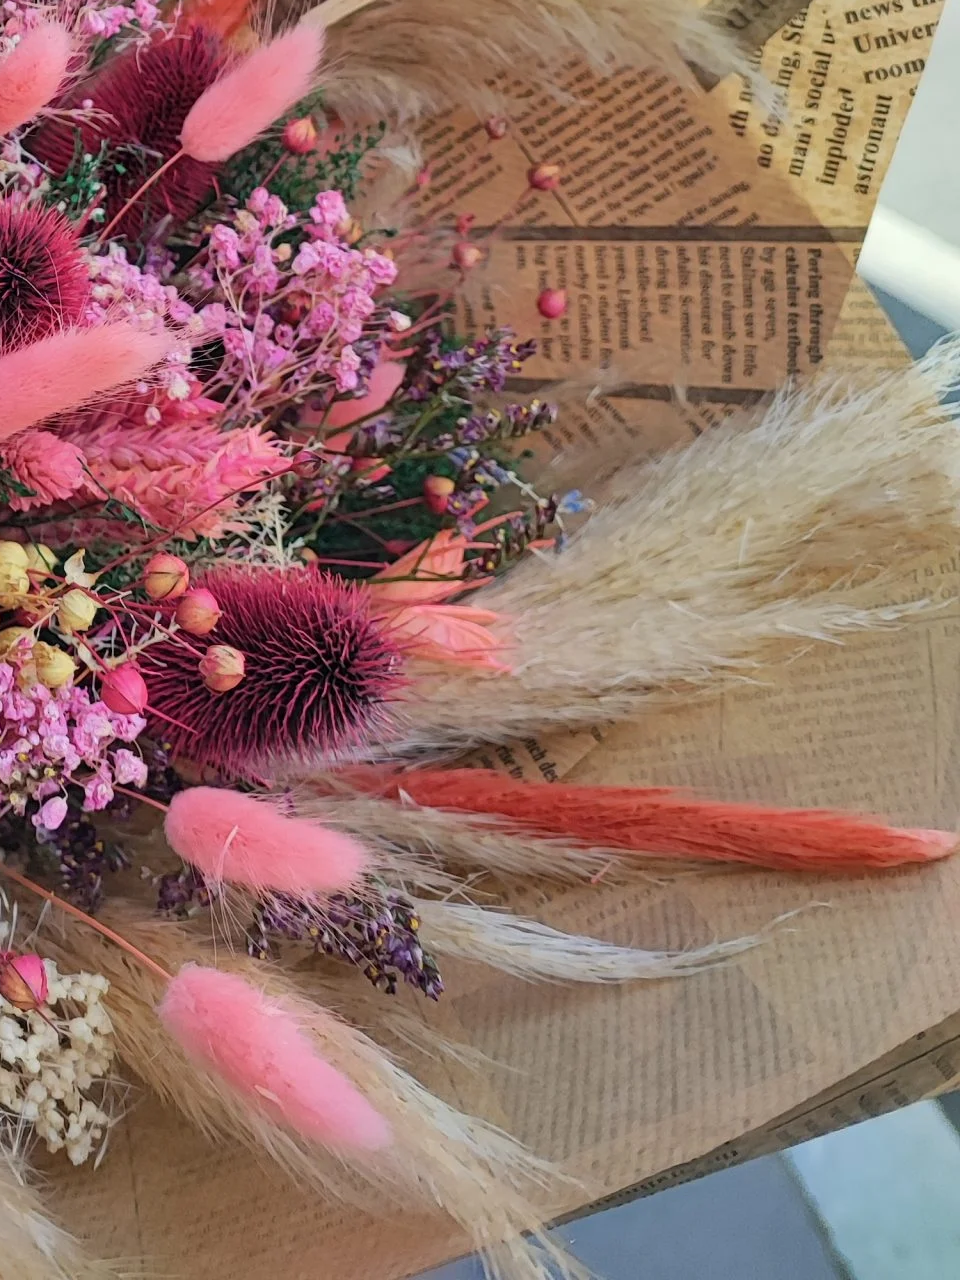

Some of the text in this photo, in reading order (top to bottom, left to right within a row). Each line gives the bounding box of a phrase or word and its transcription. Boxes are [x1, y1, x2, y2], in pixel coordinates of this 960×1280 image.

[845, 0, 903, 24] news
[789, 118, 815, 177] man's
[806, 51, 832, 108] social
[855, 95, 892, 195] astronaut
[573, 246, 588, 290] nearby
[612, 247, 626, 284] years,
[636, 246, 653, 342] middle-school
[655, 246, 670, 314] during his
[698, 247, 715, 360] his discourse for
[741, 247, 757, 376] Stallman saw little
[760, 247, 776, 341] by age seven,
[786, 247, 798, 307] calculus
[807, 249, 823, 364] Poring through
[599, 295, 611, 343] student
[719, 247, 736, 383] need to dumb down
